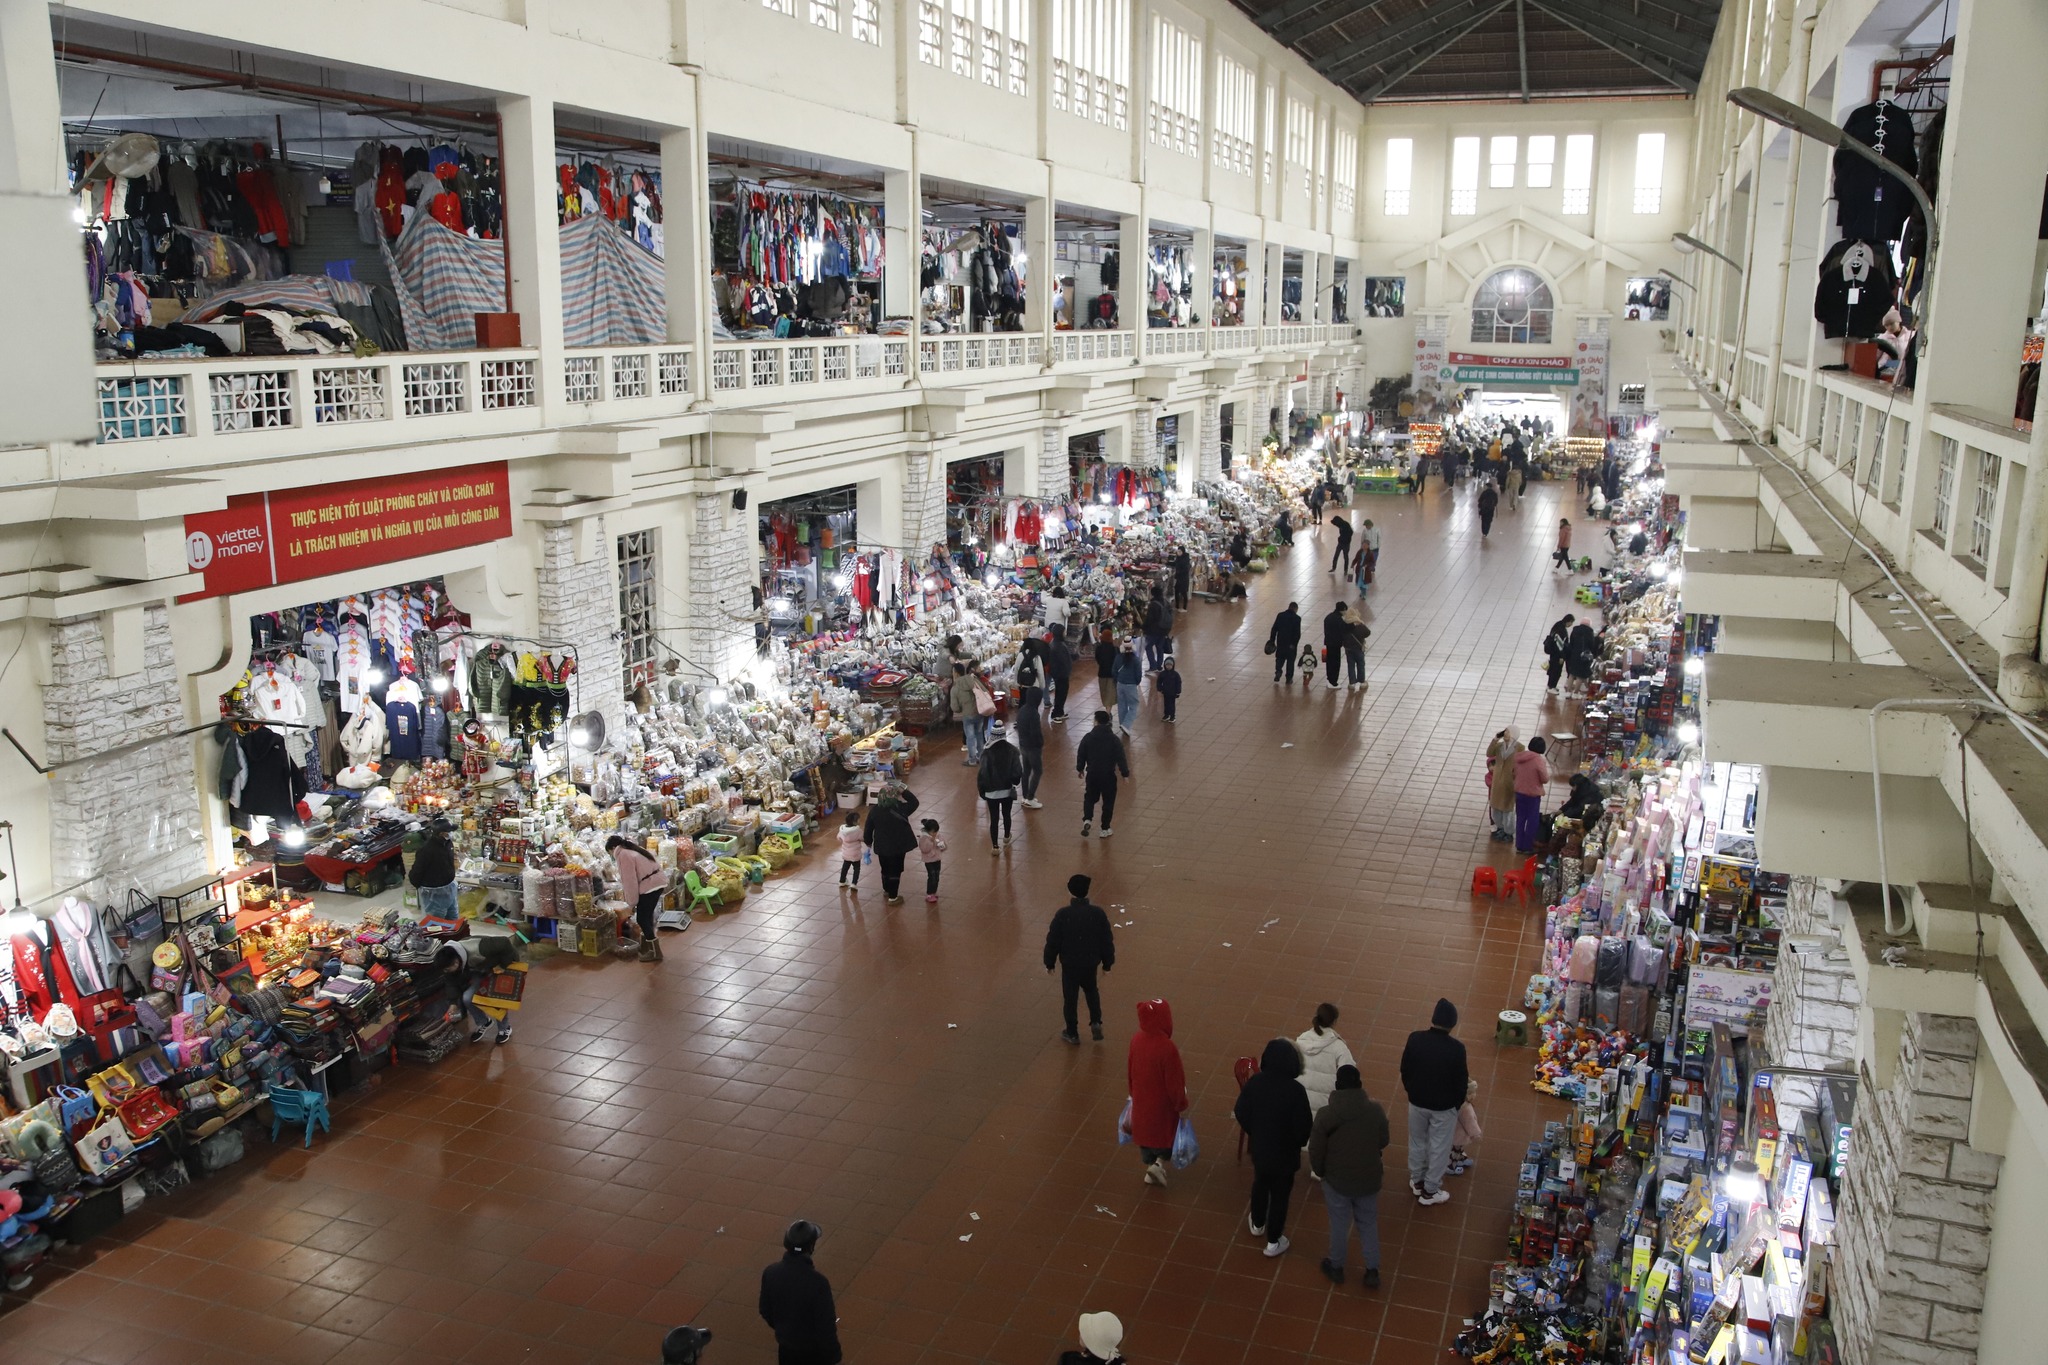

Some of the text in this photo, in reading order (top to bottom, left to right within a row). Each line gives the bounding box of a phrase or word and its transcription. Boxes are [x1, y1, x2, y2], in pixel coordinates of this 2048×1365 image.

[1420, 362, 1438, 371] SaPa
[1580, 366, 1600, 374] SaPa
[290, 480, 494, 528] THỰC HIỆN TỐT LUẬT PHÒNG CHÁY VÀ CHỮA CHÁY
[216, 525, 262, 544] viettel
[290, 504, 500, 557] LÀ TRÁCH NHIỆM VÀ NGHĨA VỤ CỦA MỖI CÔNG DÂN
[218, 540, 264, 558] money
